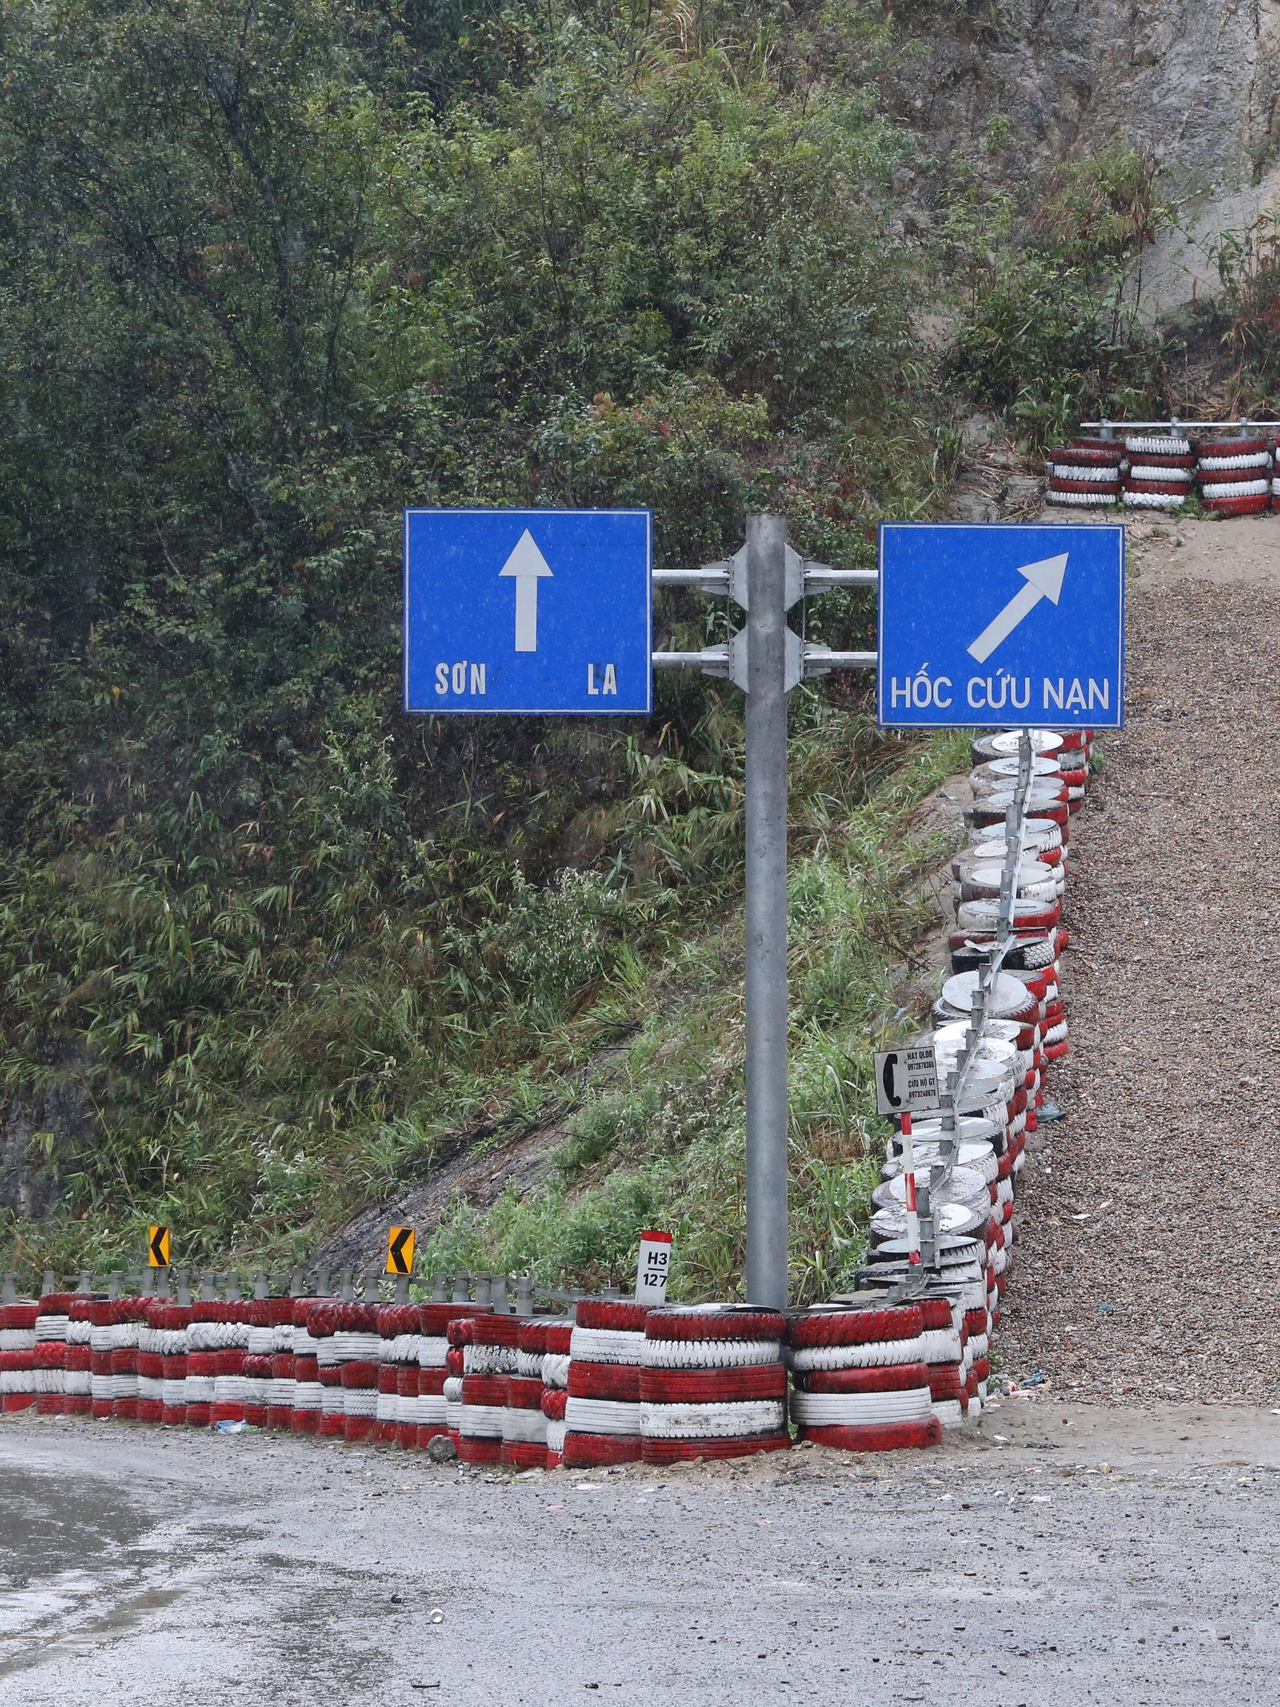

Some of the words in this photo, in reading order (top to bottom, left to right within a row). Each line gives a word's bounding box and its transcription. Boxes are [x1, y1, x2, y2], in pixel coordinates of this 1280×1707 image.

[434, 660, 487, 695] SƠN
[587, 663, 618, 695] LA
[891, 662, 953, 709] HỐC
[967, 668, 1031, 710] CỨU
[1043, 677, 1109, 715] NẠN
[929, 1077, 935, 1086] GT
[648, 1251, 668, 1265] H3
[643, 1273, 668, 1287] 127
